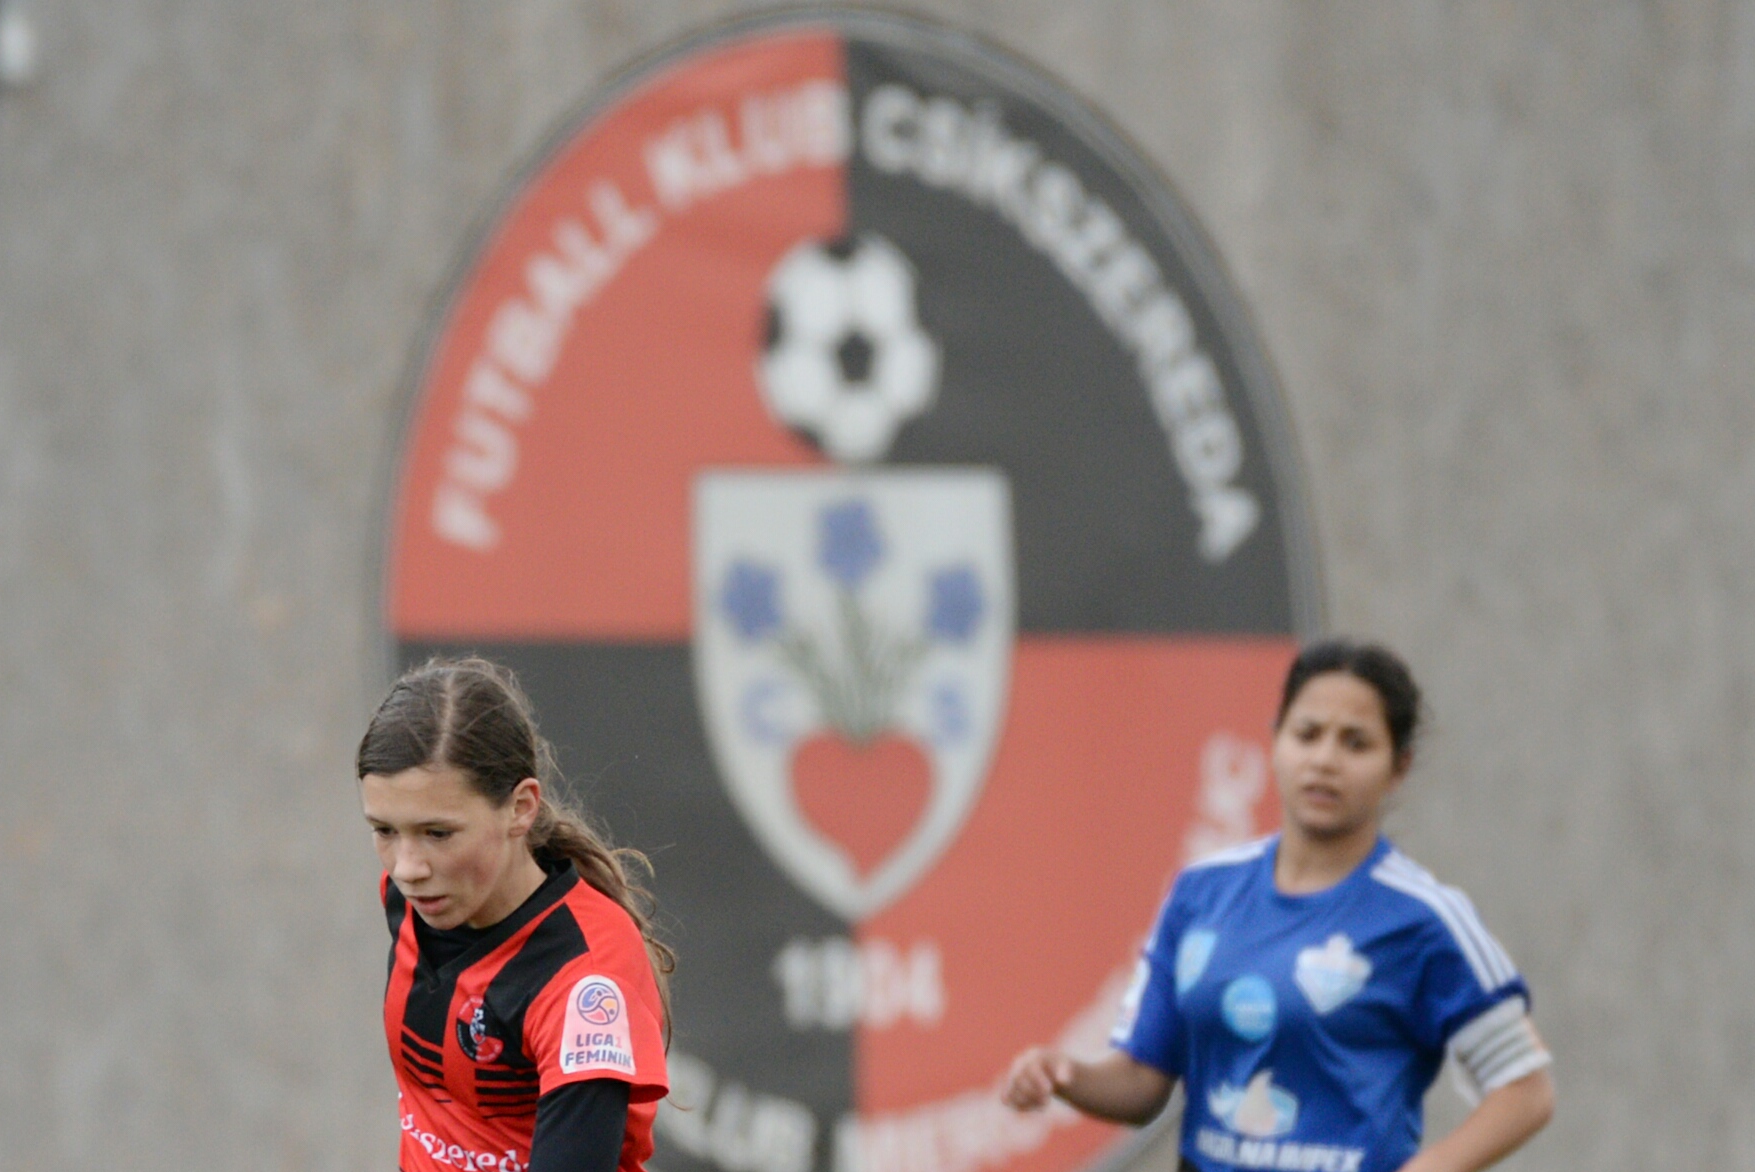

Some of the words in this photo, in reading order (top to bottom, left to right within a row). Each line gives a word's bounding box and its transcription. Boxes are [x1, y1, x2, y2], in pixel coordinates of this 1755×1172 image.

[432, 180, 656, 552] FUTBALL
[646, 78, 852, 212] KLUB
[565, 1049, 632, 1068] FEMININ
